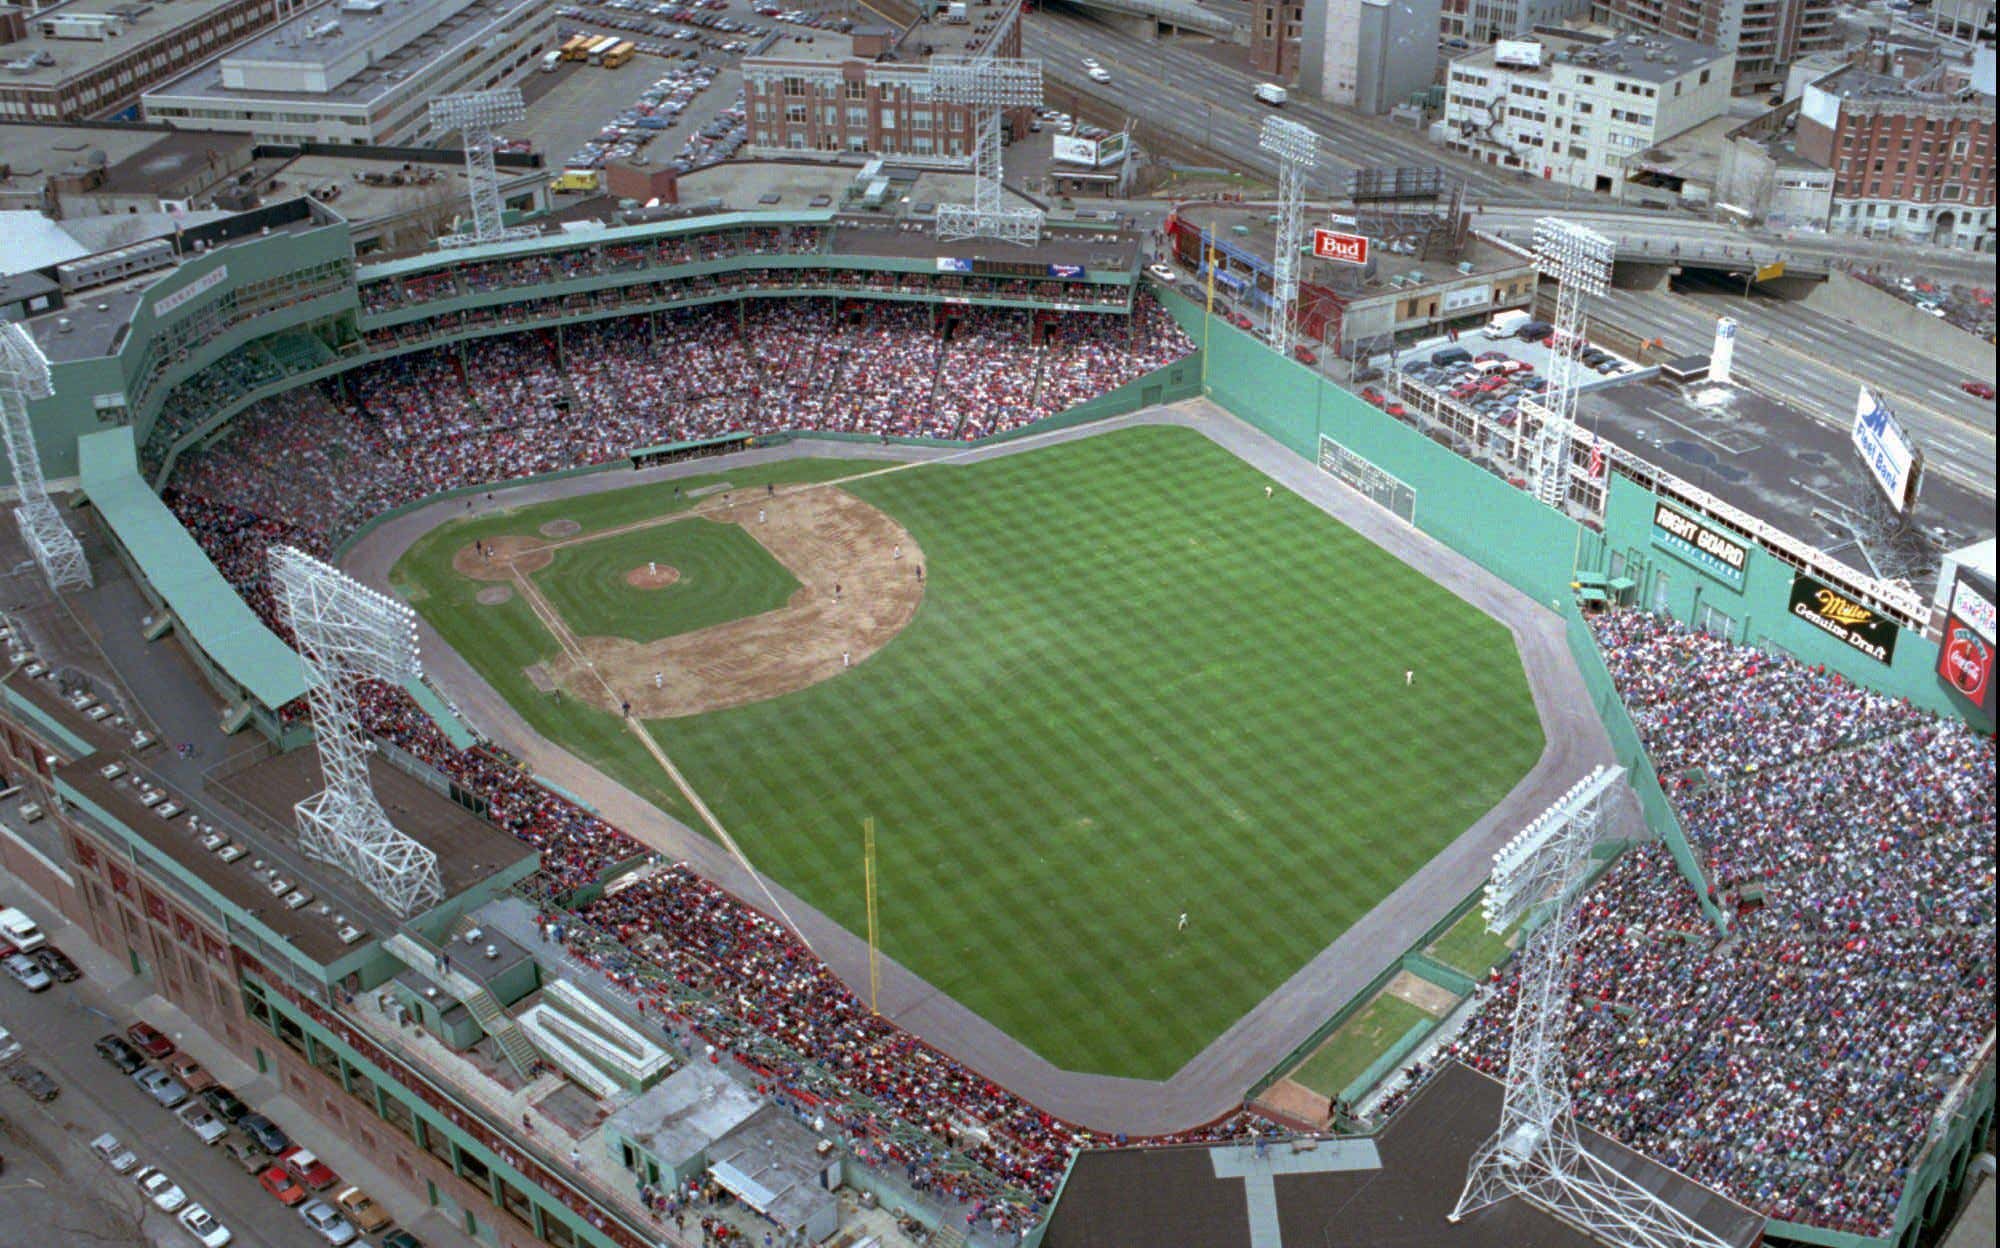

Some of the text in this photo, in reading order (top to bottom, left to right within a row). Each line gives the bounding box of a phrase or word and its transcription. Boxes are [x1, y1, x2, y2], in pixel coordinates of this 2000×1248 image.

[1322, 237, 1359, 256] Bud
[1875, 452, 1897, 494] Bank
[1656, 507, 1745, 569] RIGHT GUARD
[1817, 589, 1872, 621] Miller
[1795, 602, 1887, 660] Genuine Draft
